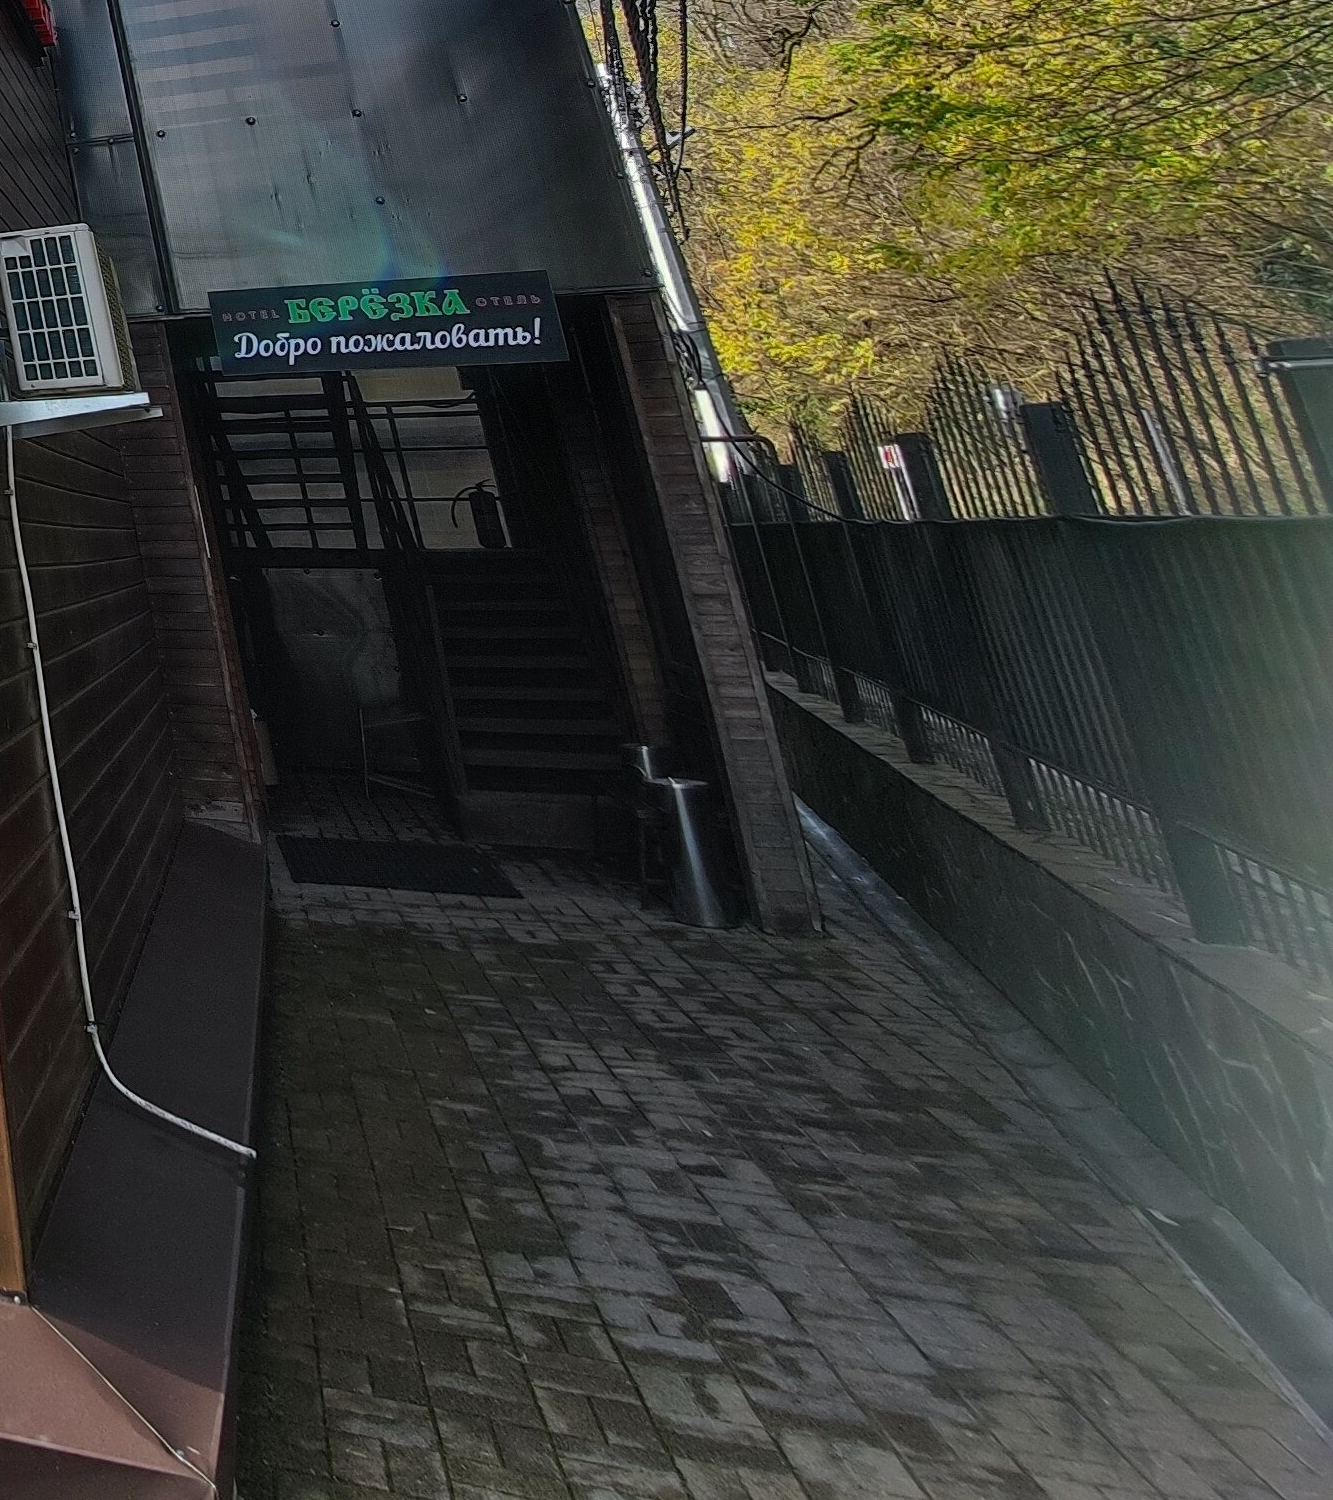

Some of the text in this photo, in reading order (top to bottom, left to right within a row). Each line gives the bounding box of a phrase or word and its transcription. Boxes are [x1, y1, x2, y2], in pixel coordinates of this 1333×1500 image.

[221, 288, 541, 323] HOTEL БЕРЁЗКА ОТЕЛЬ
[233, 317, 542, 366] Добро пожаловать!
